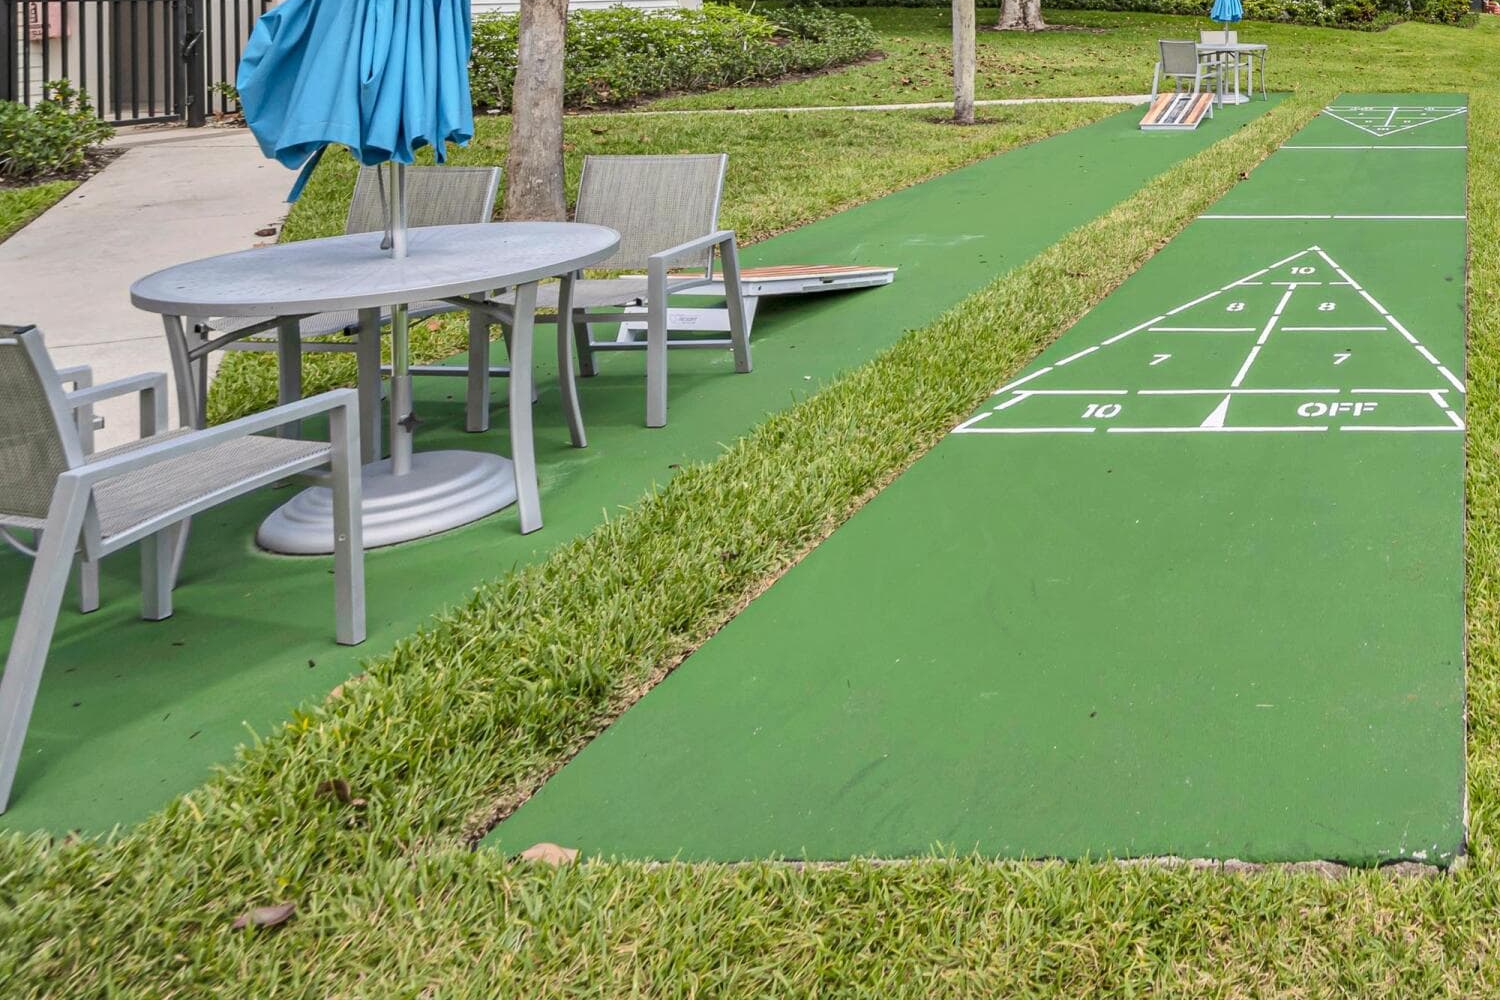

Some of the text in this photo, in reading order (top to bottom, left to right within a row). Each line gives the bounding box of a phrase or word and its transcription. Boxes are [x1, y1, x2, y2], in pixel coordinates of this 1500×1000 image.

[1290, 266, 1316, 275] 10
[1226, 302, 1245, 312] 8
[1317, 302, 1337, 312] 8
[1148, 353, 1172, 366] 7
[1333, 352, 1352, 366] 7
[1080, 401, 1379, 419] 10 OFF
